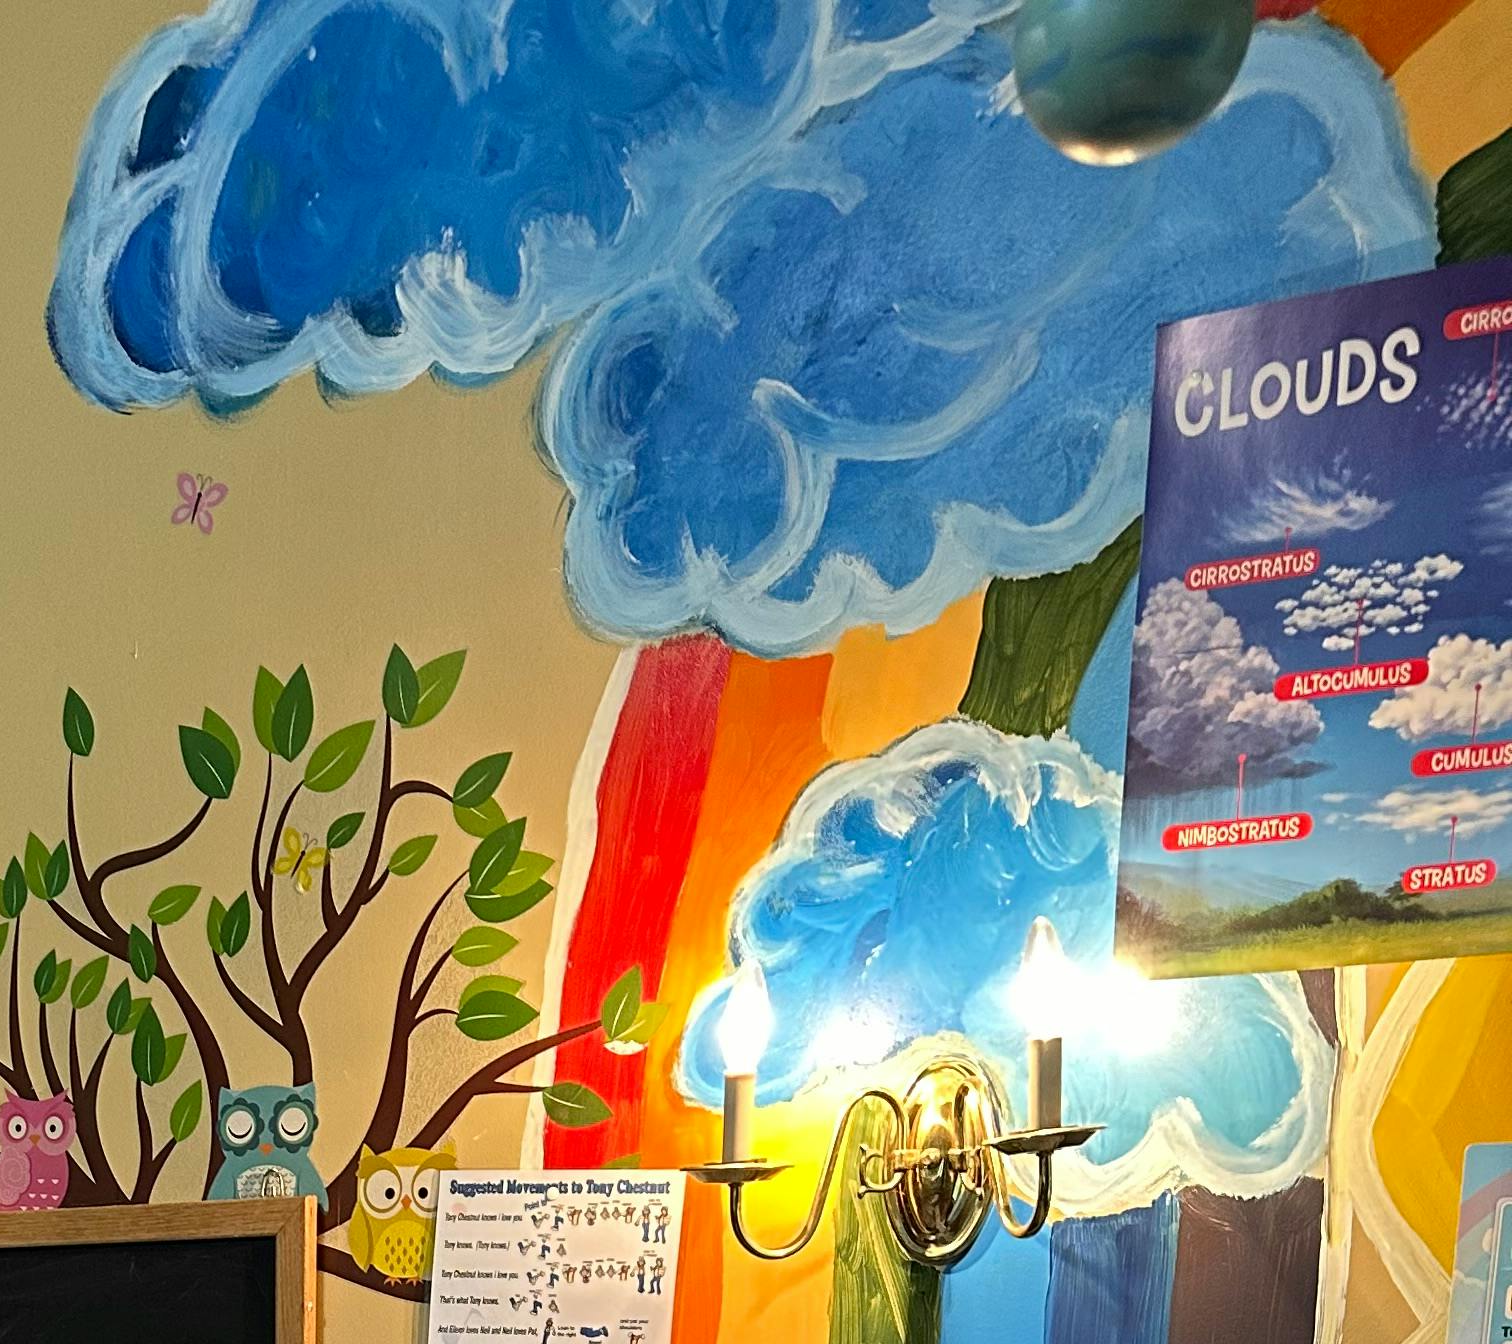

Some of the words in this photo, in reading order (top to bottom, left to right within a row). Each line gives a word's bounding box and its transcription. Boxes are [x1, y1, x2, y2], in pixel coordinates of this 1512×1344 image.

[1175, 327, 1421, 437] CLOUDS
[1189, 552, 1316, 587] CIRROSTRATUS
[1291, 663, 1411, 696] ALTOCUMULUS
[1431, 743, 1512, 772] CUMULUS
[1177, 816, 1300, 847] NIMBOSTRATUS
[1409, 863, 1486, 889] STRATUS
[450, 1180, 503, 1196] Suggested
[572, 1180, 582, 1193] to
[586, 1180, 614, 1196] Tony
[617, 1180, 670, 1194] Chestnut
